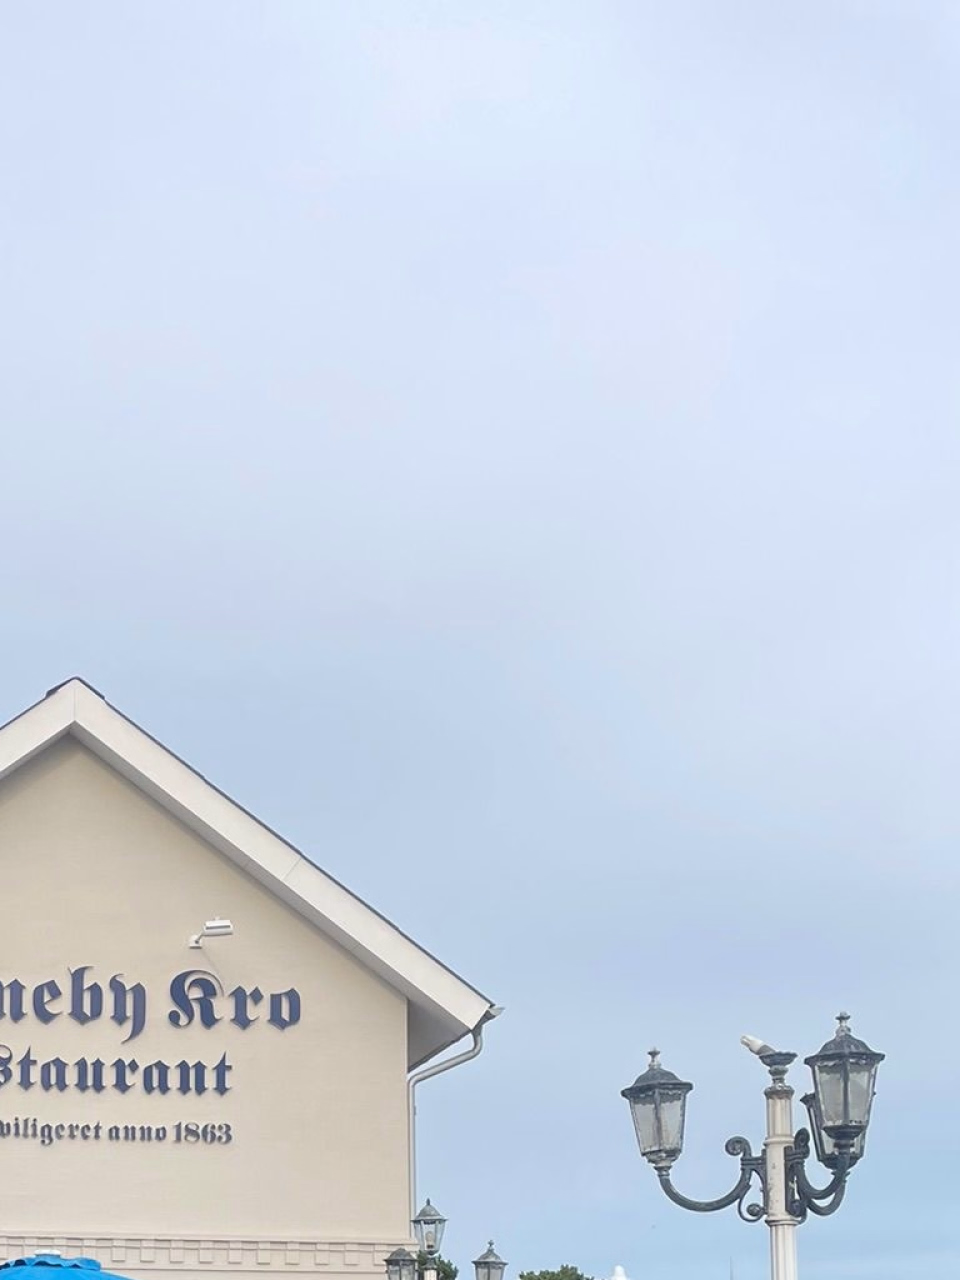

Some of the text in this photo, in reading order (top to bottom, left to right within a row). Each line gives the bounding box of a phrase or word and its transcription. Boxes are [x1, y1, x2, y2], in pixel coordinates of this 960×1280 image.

[168, 970, 301, 1031] Kro
[108, 1123, 167, 1142] anno
[173, 1121, 233, 1145] 1863
